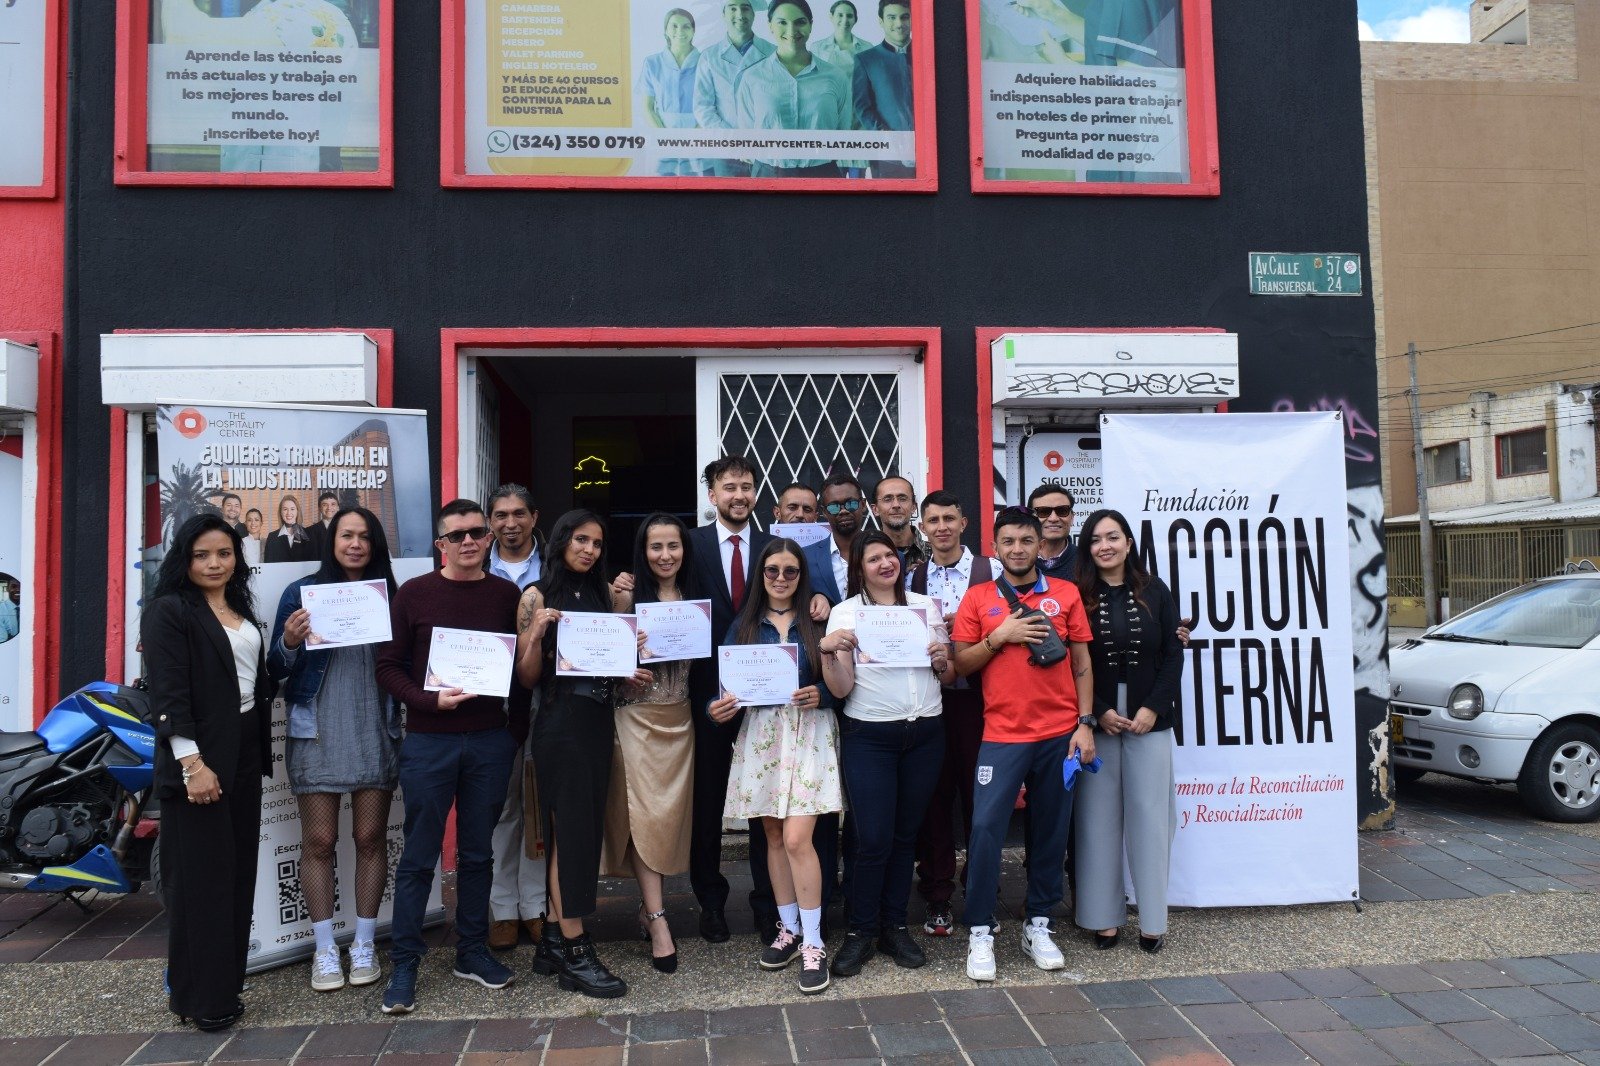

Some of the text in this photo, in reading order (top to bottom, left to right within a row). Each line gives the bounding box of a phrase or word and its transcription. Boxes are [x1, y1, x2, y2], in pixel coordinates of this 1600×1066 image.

[501, 16, 564, 24] BARTENDER
[185, 50, 342, 64] Aprende las técnicas
[502, 50, 584, 59] VALET PARKING
[542, 62, 598, 71] HOTELERO
[166, 69, 357, 85] más actuales y trabaja en
[502, 74, 619, 85] Y MÁS DE 40 CURSOS
[1015, 73, 1157, 88] Adquiere habilidades
[182, 88, 342, 103] los mejores bares del
[502, 84, 587, 94] DE EDUCACIÓN
[502, 96, 612, 105] CONTINUA PARA LA
[990, 89, 1182, 109] indispensables para trabajar
[231, 109, 289, 121] mundo.
[502, 106, 564, 115] INDUSTRIA
[997, 110, 1174, 125] en hoteles de primer nivel.
[288, 129, 320, 143] hoy!
[512, 135, 646, 150] (324) 350 0719
[1015, 128, 1159, 144] Pregunta por nuestra
[657, 138, 890, 150] WWW.THEHOSPITALITYCENTER-LATAM.COM
[1021, 147, 1155, 164] modalidad de pago.
[1326, 255, 1341, 276] 57
[1327, 276, 1342, 292] 24
[228, 411, 246, 420] THE
[208, 420, 266, 430] HOSPITALITY
[219, 429, 256, 439] CENTER
[200, 443, 389, 468] ¿QUIERES TRABAJAR EN
[201, 467, 388, 490] LA INDUSTRIA HORECA?
[1041, 477, 1101, 487] SIGUENOS
[1068, 488, 1095, 496] ERATE
[1073, 497, 1102, 505] UNIDA
[1142, 489, 1250, 512] Fundación
[1173, 637, 1333, 746] TERNA
[1175, 774, 1345, 796] mino a la Reconciliación
[1181, 802, 1303, 829] y Resocialización
[275, 934, 292, 944] +57
